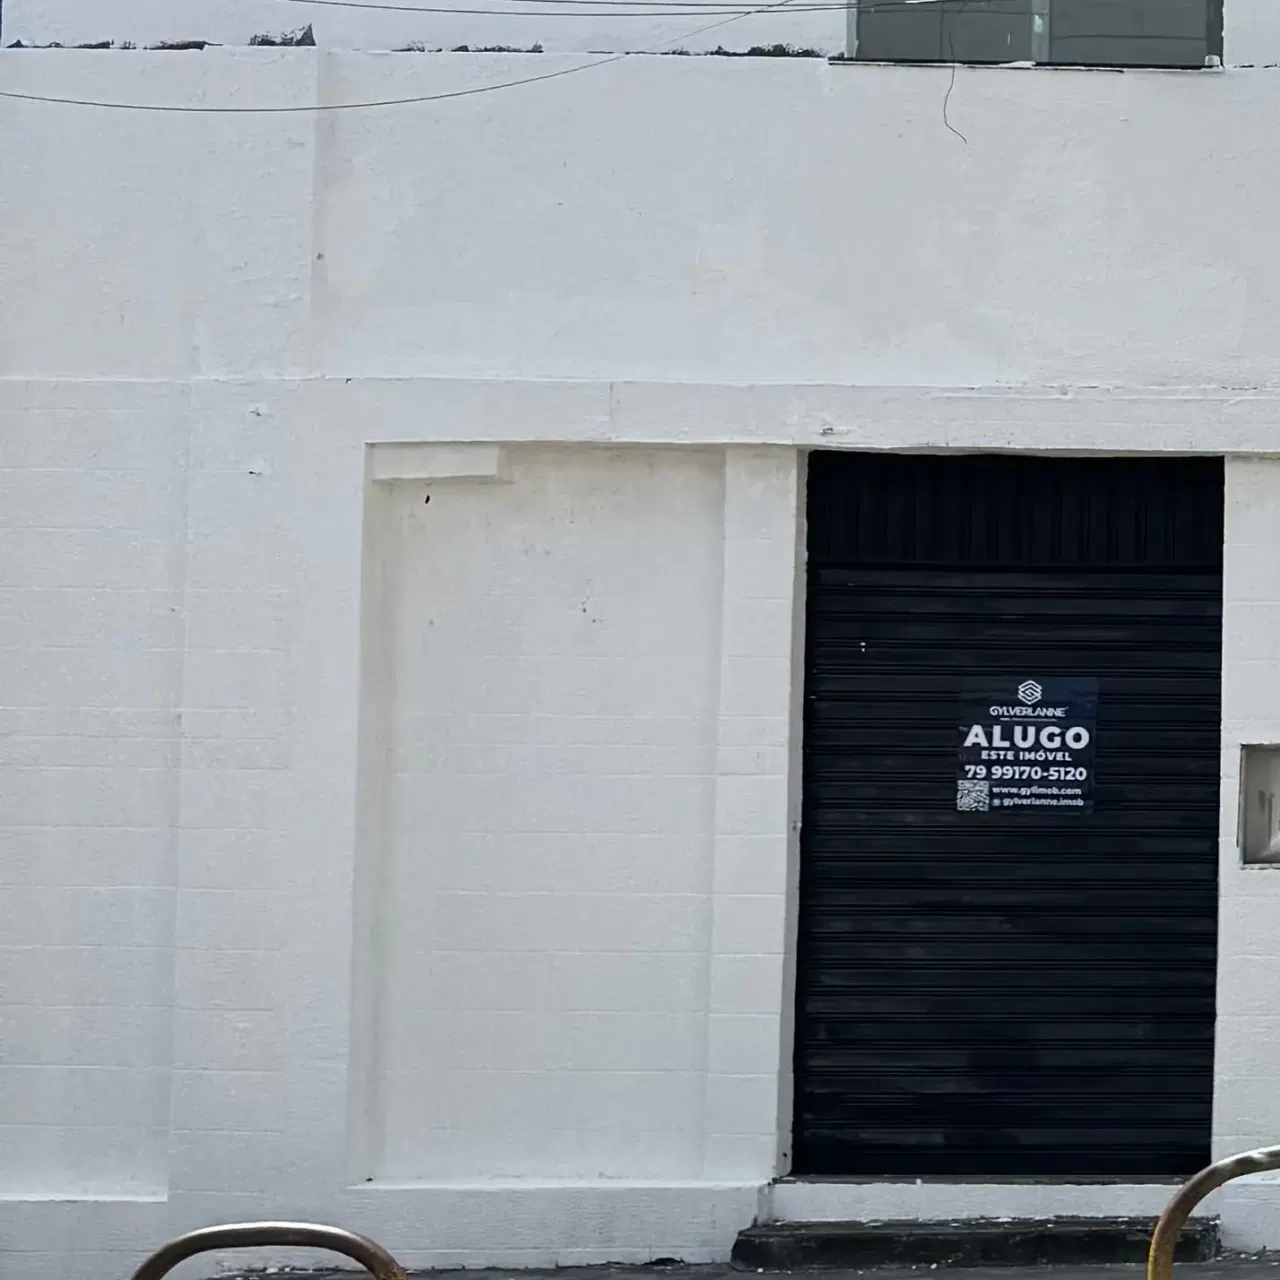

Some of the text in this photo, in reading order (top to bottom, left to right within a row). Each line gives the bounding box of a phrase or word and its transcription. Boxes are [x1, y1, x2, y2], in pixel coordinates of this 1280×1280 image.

[963, 724, 1090, 750] ALUGO
[981, 749, 1072, 762] ESTE IMÓVEL
[964, 765, 1087, 781] 79 99170-5120
